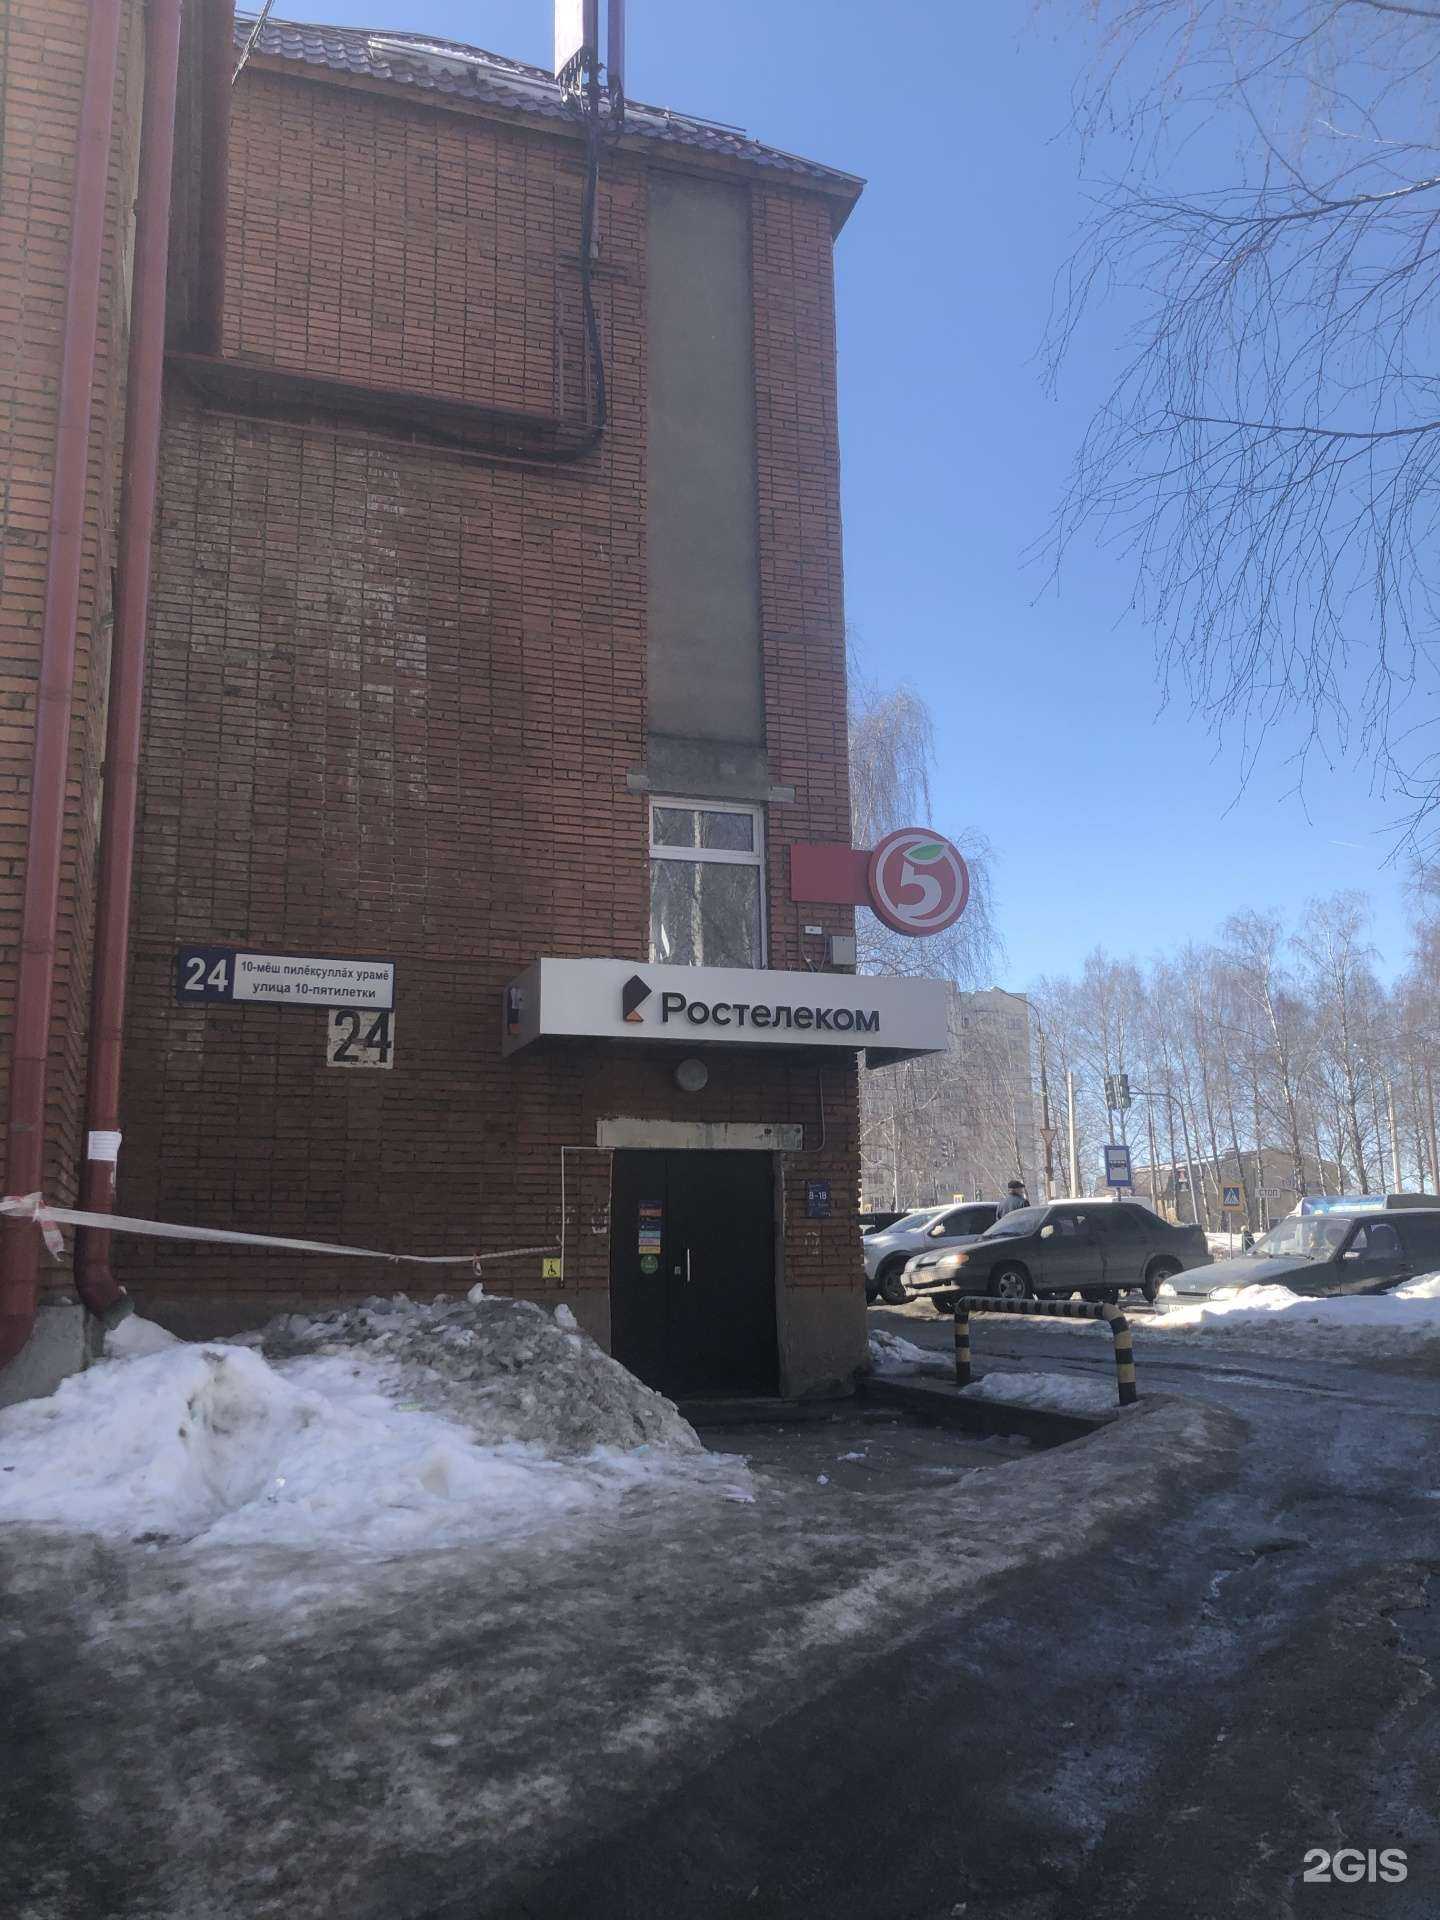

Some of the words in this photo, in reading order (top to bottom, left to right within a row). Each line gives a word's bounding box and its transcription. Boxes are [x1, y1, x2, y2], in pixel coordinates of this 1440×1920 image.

[897, 860, 942, 918] 5
[184, 957, 229, 992] 24
[252, 983, 291, 994] улица
[295, 983, 376, 998] 10-пятилетки
[661, 991, 880, 1032] Ростелеком
[333, 1009, 392, 1063] 24
[1258, 1188, 1278, 1197] СТОП
